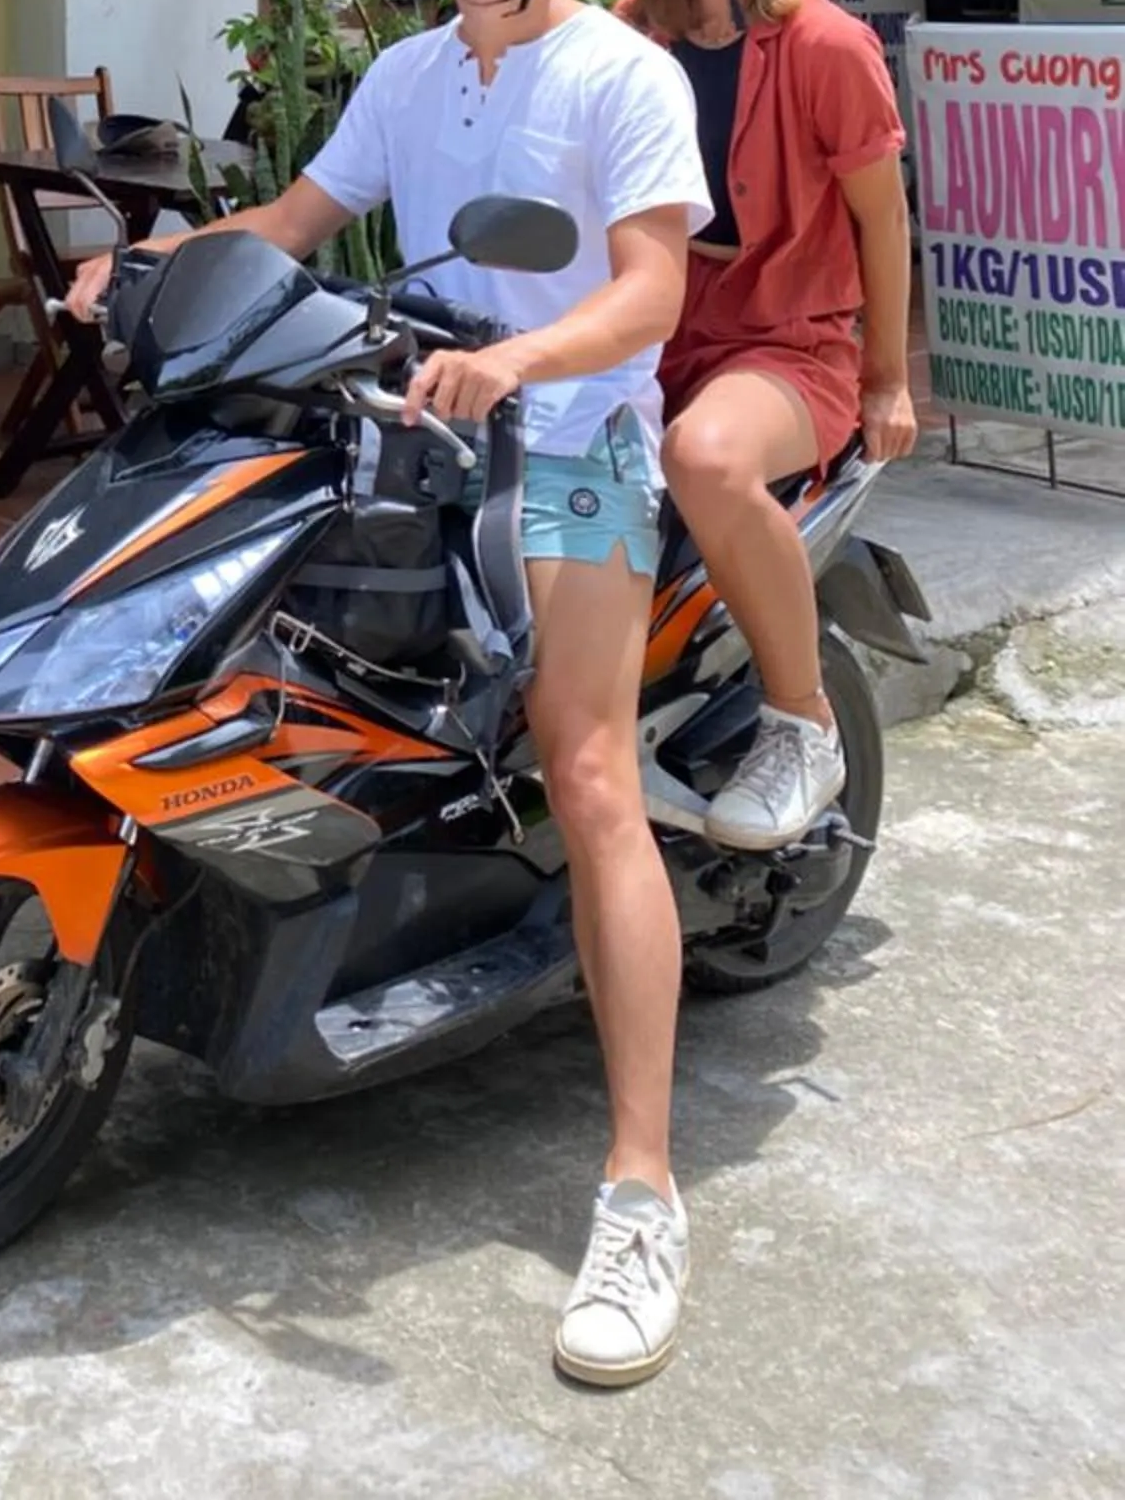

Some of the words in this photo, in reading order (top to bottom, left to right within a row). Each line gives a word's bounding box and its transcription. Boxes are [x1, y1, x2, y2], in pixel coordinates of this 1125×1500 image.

[938, 296, 1020, 352] BICYCLE:
[930, 353, 1043, 416] MOTORBIKE:
[160, 774, 256, 811] HONDA
